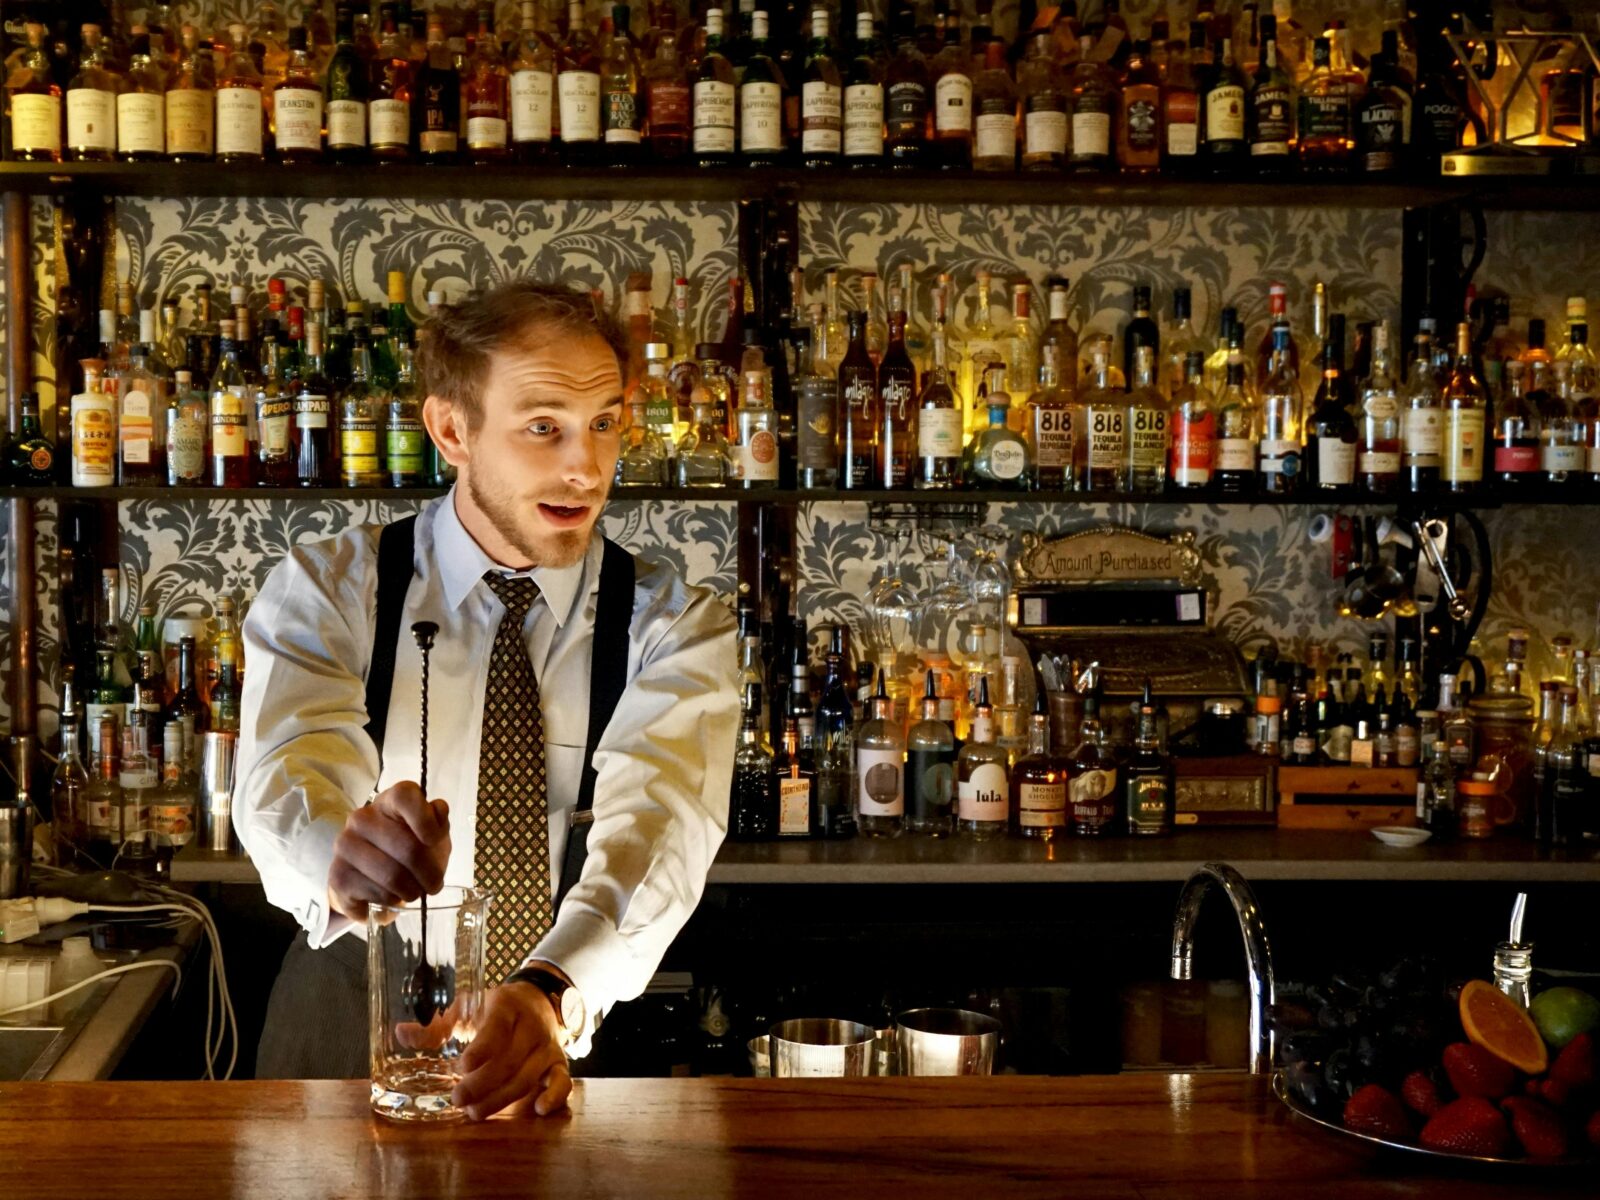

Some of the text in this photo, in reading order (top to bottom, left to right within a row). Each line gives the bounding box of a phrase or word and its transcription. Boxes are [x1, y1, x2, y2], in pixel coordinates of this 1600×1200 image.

[427, 110, 444, 125] IPA
[262, 401, 290, 416] APERO
[1041, 412, 1072, 431] 818
[1094, 413, 1122, 433] 818
[1135, 411, 1165, 430] 818
[1040, 433, 1072, 442] TEQUILA
[1093, 435, 1122, 443] TEQUILA
[1134, 432, 1165, 441] TEQUILA
[1040, 551, 1172, 574] Amount Purchased
[976, 790, 1002, 802] lula
